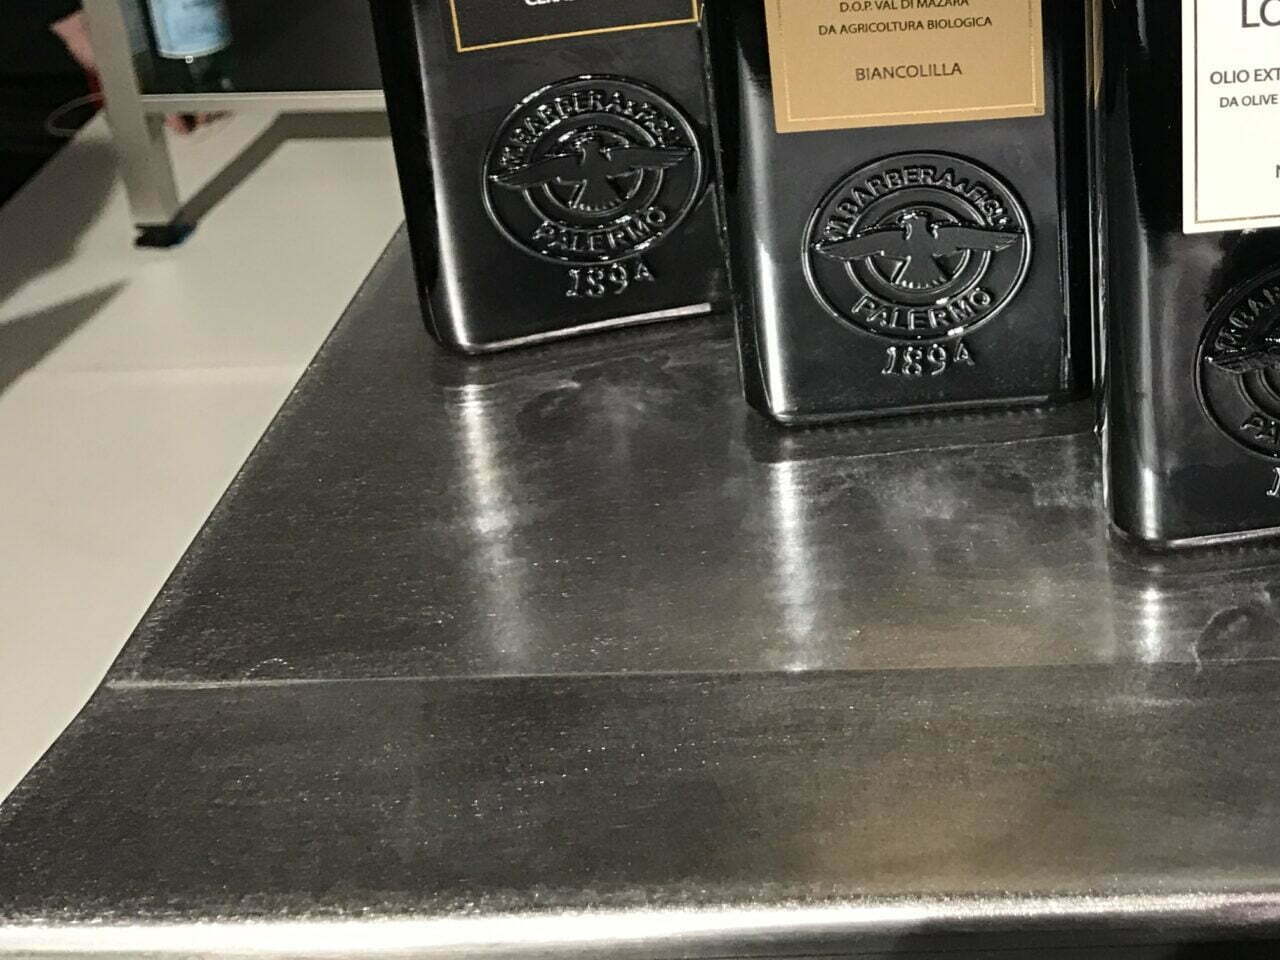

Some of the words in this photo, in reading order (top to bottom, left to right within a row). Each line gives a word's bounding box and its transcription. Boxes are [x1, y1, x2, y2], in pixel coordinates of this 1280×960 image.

[875, 0, 898, 11] VAL
[818, 23, 837, 36] DA
[840, 20, 925, 35] AGRICOLTURA
[927, 16, 993, 31] BIOLOGICA
[855, 62, 962, 82] BIANCOLILLA
[1209, 70, 1250, 85] OLIO
[1219, 96, 1239, 109] DA
[1241, 93, 1279, 107] OLIVE
